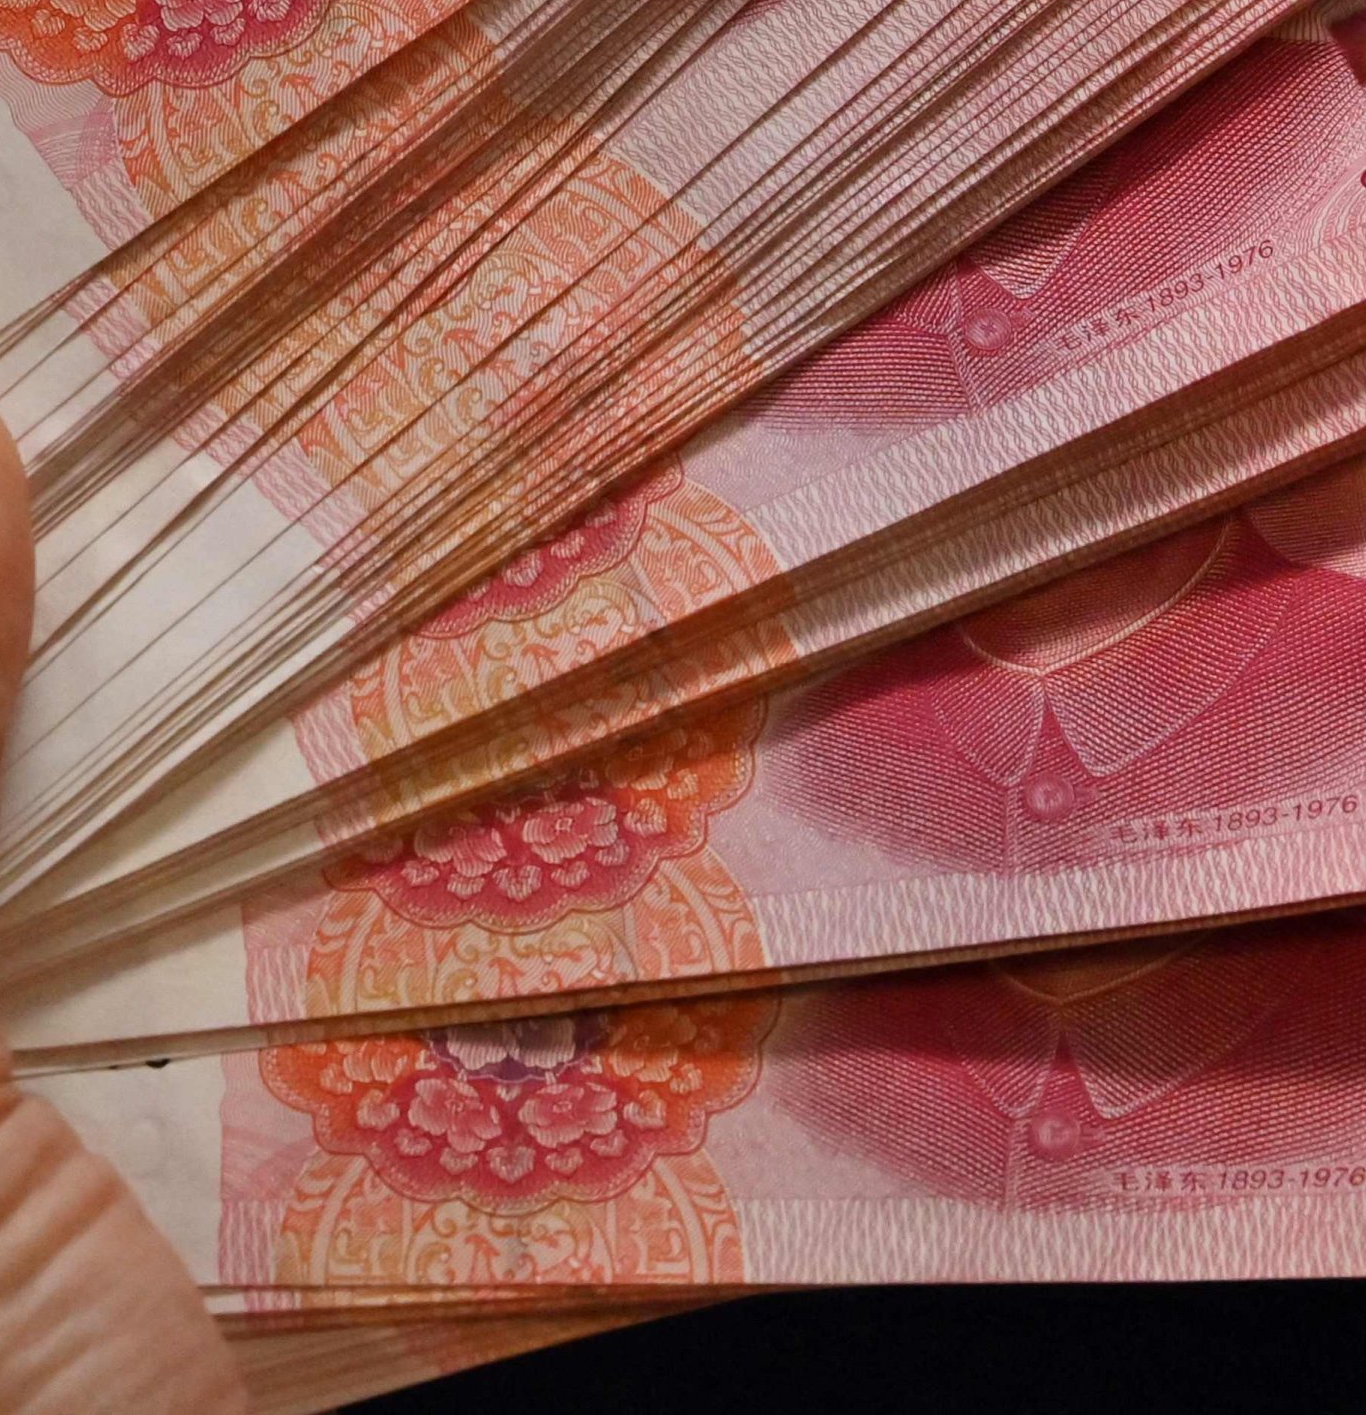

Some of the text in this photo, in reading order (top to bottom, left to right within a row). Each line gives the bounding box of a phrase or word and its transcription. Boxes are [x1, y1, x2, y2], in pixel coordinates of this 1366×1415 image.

[1145, 239, 1274, 313] 1893-1976
[1111, 793, 1358, 844] 毛泽东 1893-1976
[1112, 1166, 1366, 1193] 毛泽东 1893-1976
